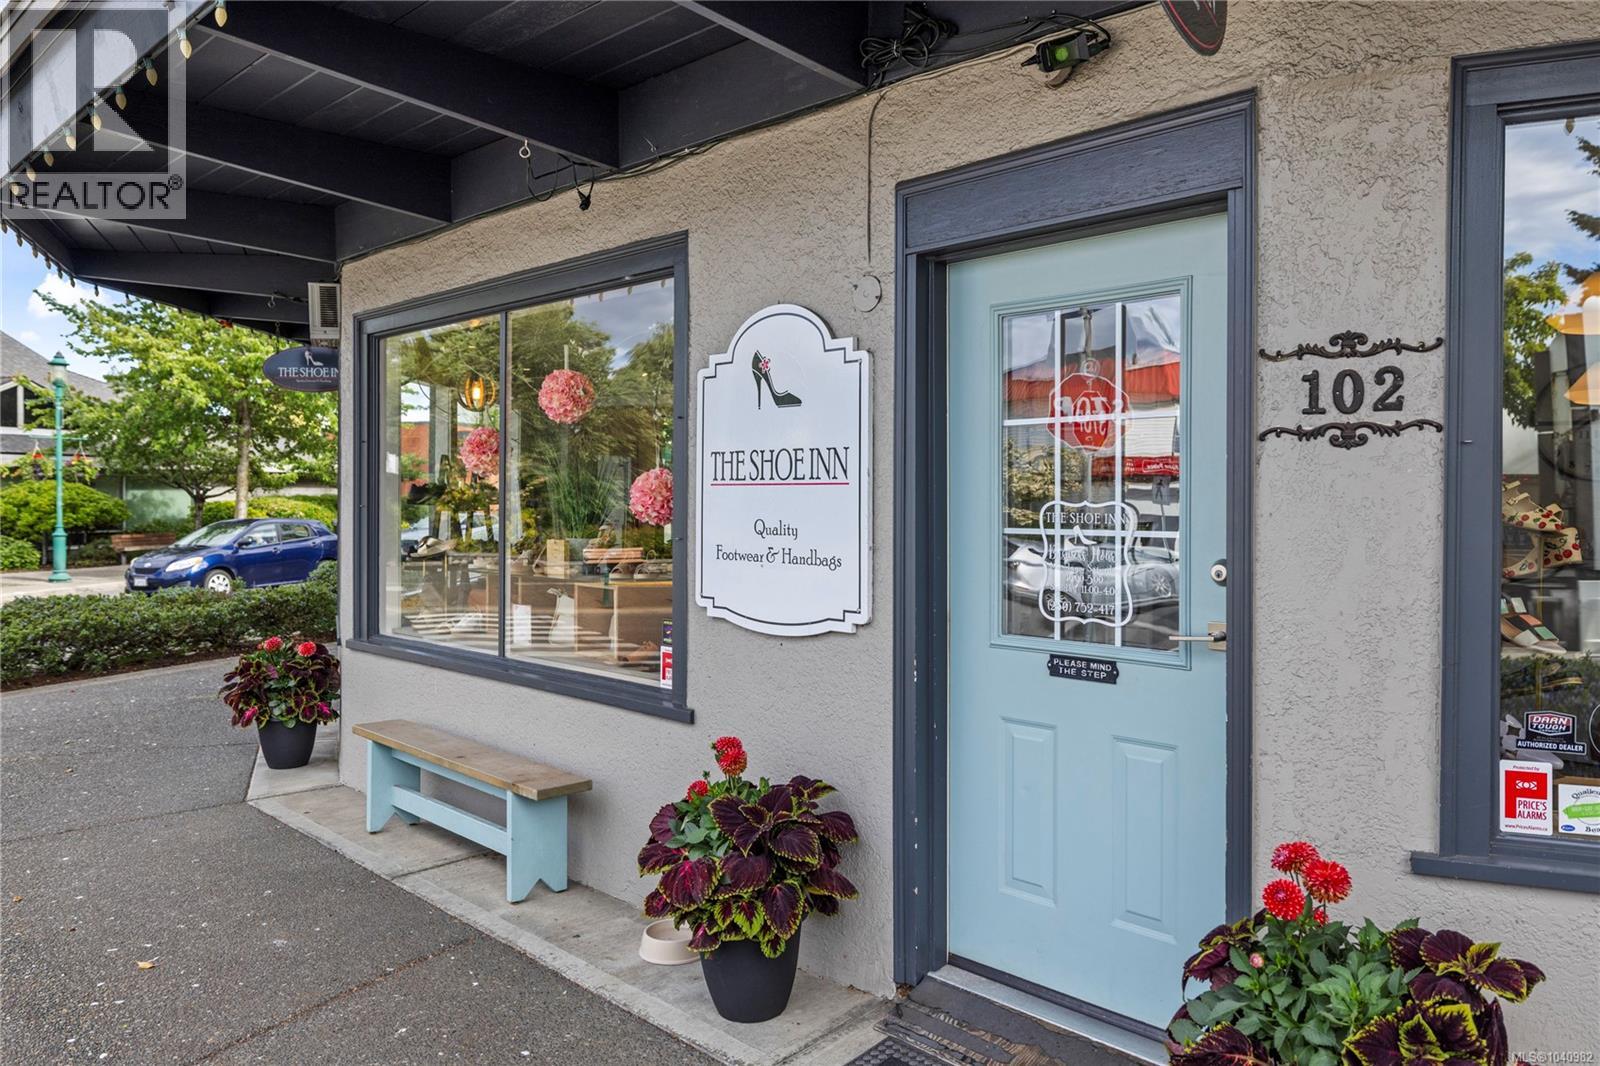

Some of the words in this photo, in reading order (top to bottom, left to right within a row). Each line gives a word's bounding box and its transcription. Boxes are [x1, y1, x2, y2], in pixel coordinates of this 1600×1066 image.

[278, 367, 299, 378] THE
[299, 367, 330, 378] SHOE
[1301, 365, 1405, 415] 102
[710, 449, 747, 482] THE
[749, 447, 806, 481] SHOE
[808, 446, 850, 480] INN
[1069, 511, 1101, 526] SHOE
[753, 518, 798, 541] Quality
[715, 544, 765, 563] Footwear
[765, 546, 780, 564] &
[781, 547, 842, 572] Handbags
[1047, 599, 1072, 613] (20)
[1053, 657, 1088, 669] PLEASE
[1089, 662, 1112, 672] MIND
[1059, 666, 1077, 676] THE
[1081, 669, 1107, 680] STEP
[1531, 722, 1567, 731] TOUGH
[1532, 715, 1568, 725] DARN
[1517, 740, 1558, 750] AUTHORIZED
[1558, 743, 1584, 752] DEALER
[1517, 800, 1548, 811] PRICE'S
[1517, 810, 1547, 821] ALARMS
